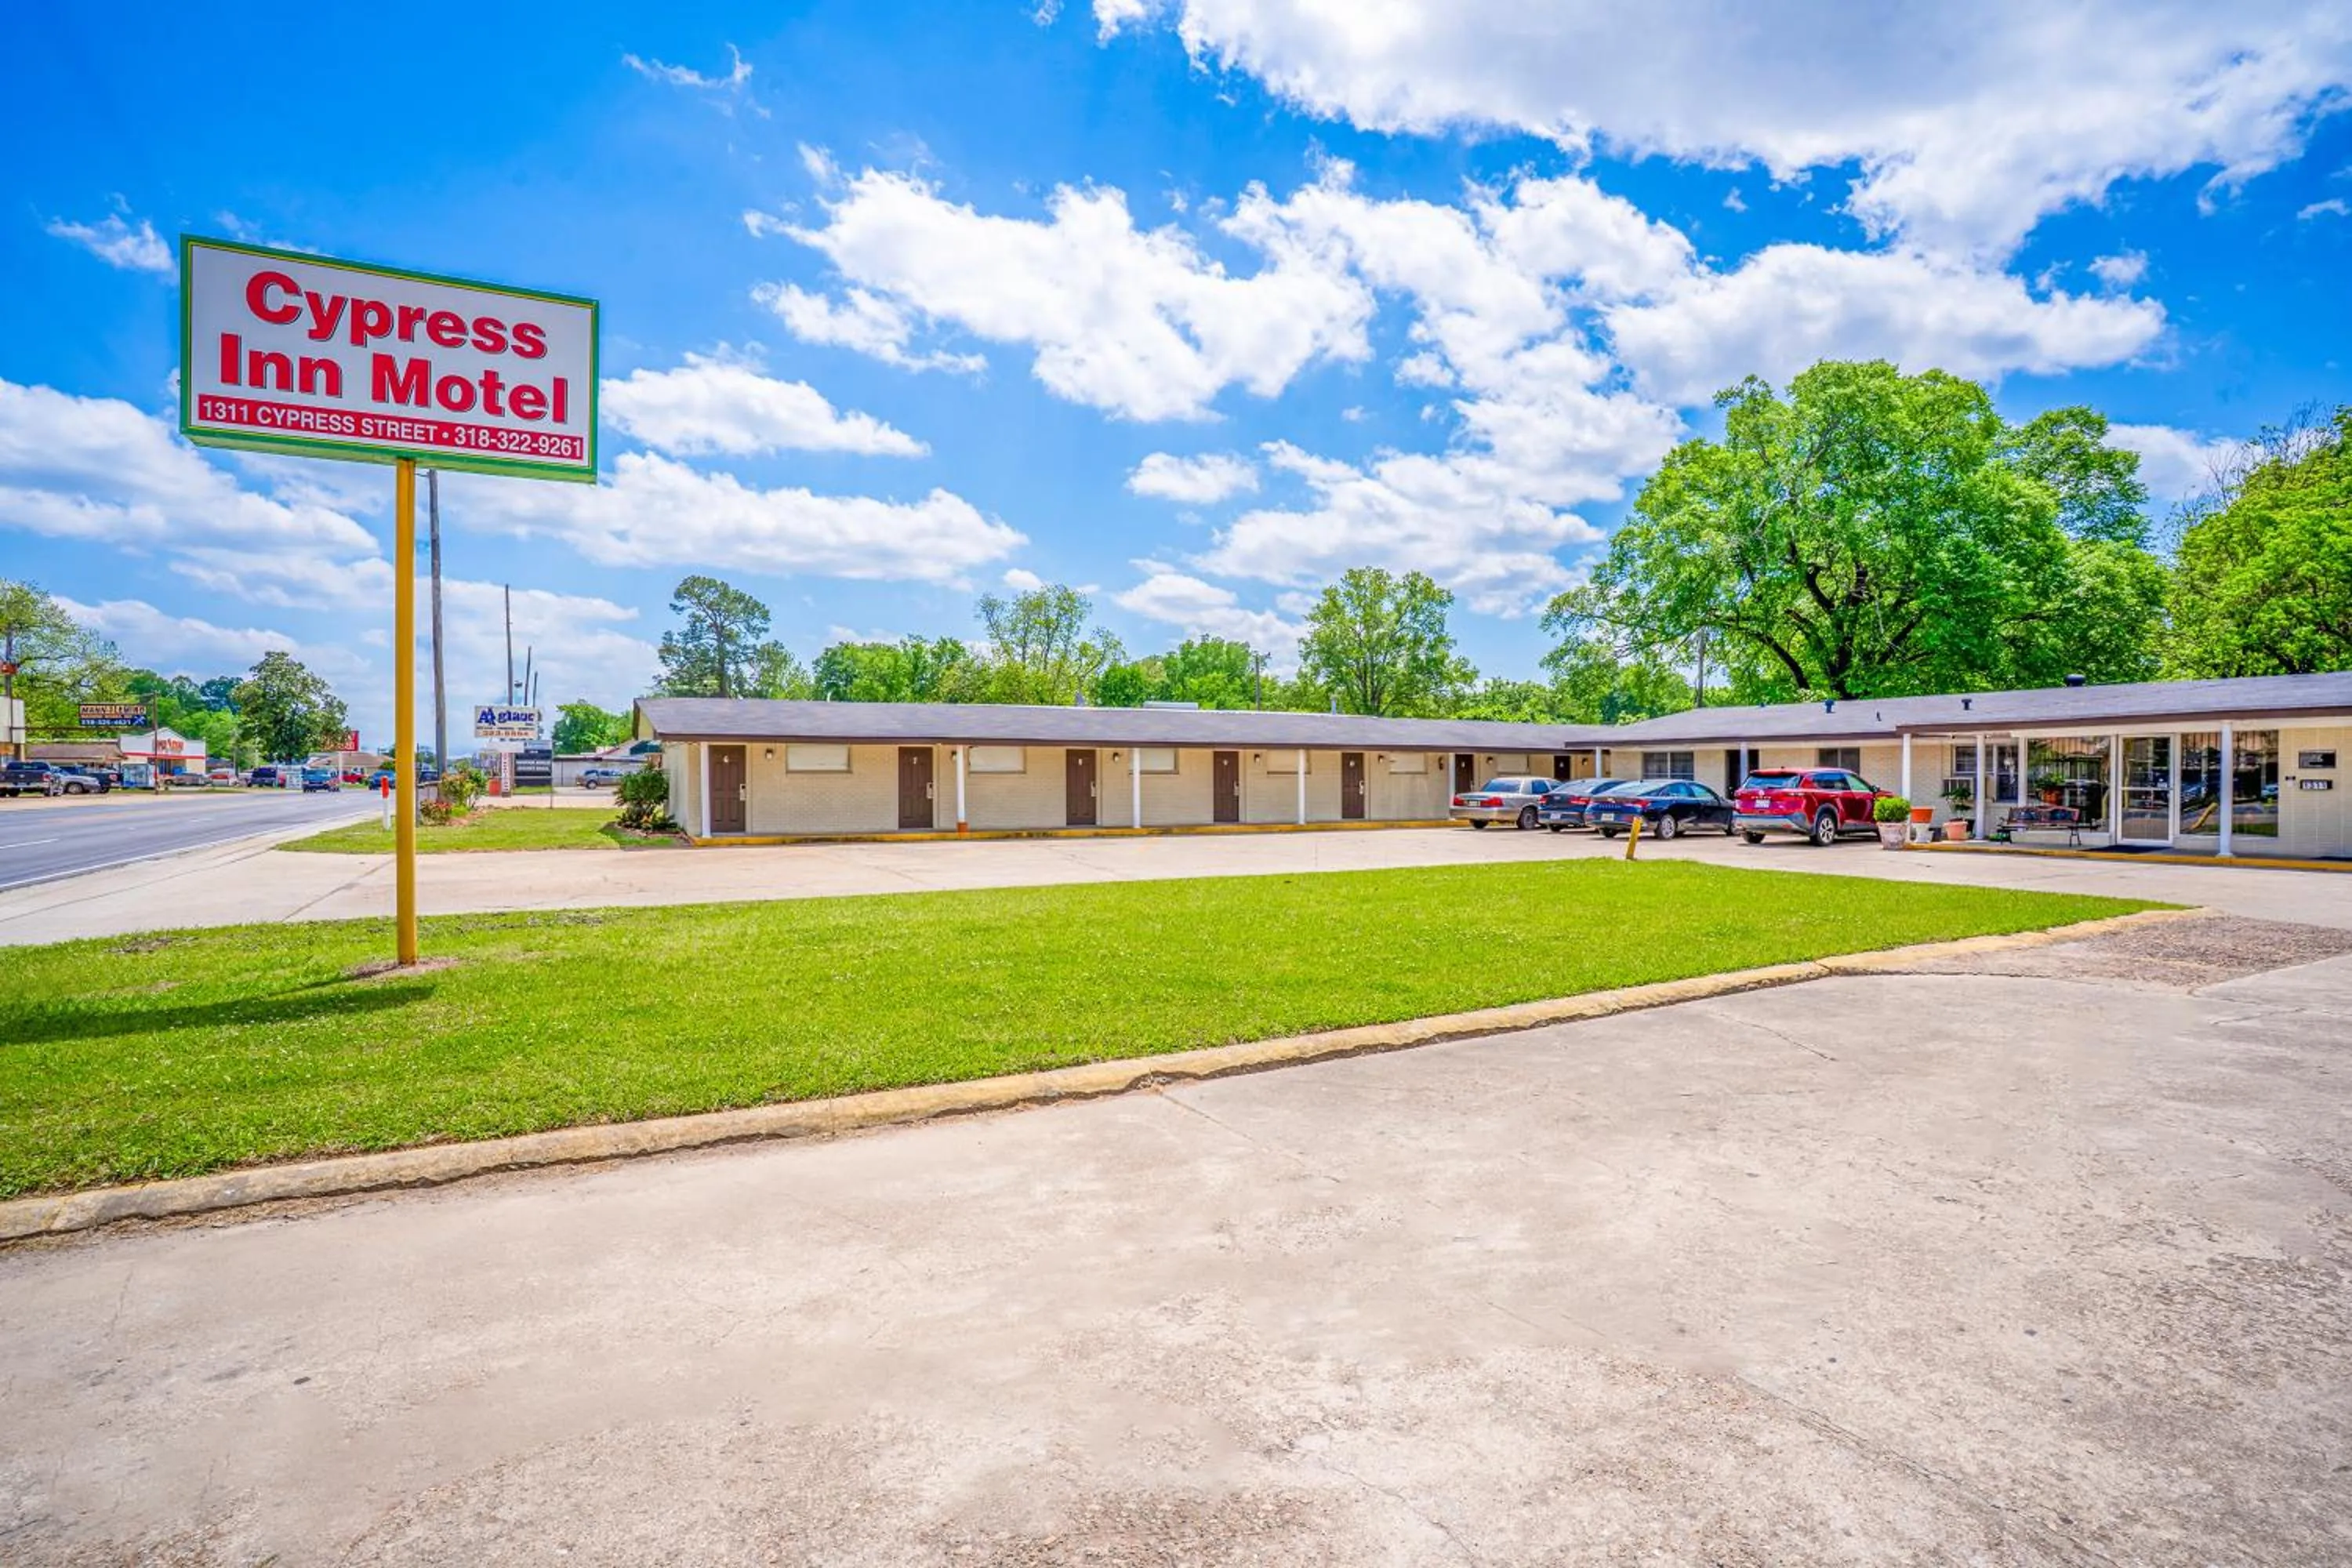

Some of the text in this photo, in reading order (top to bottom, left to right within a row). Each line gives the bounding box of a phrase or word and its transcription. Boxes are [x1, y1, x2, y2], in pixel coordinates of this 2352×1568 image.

[245, 270, 547, 359] Cypress
[220, 332, 568, 424] Inn Motel
[202, 400, 583, 459] 1311 CYPRESS STREET 318-322-9261
